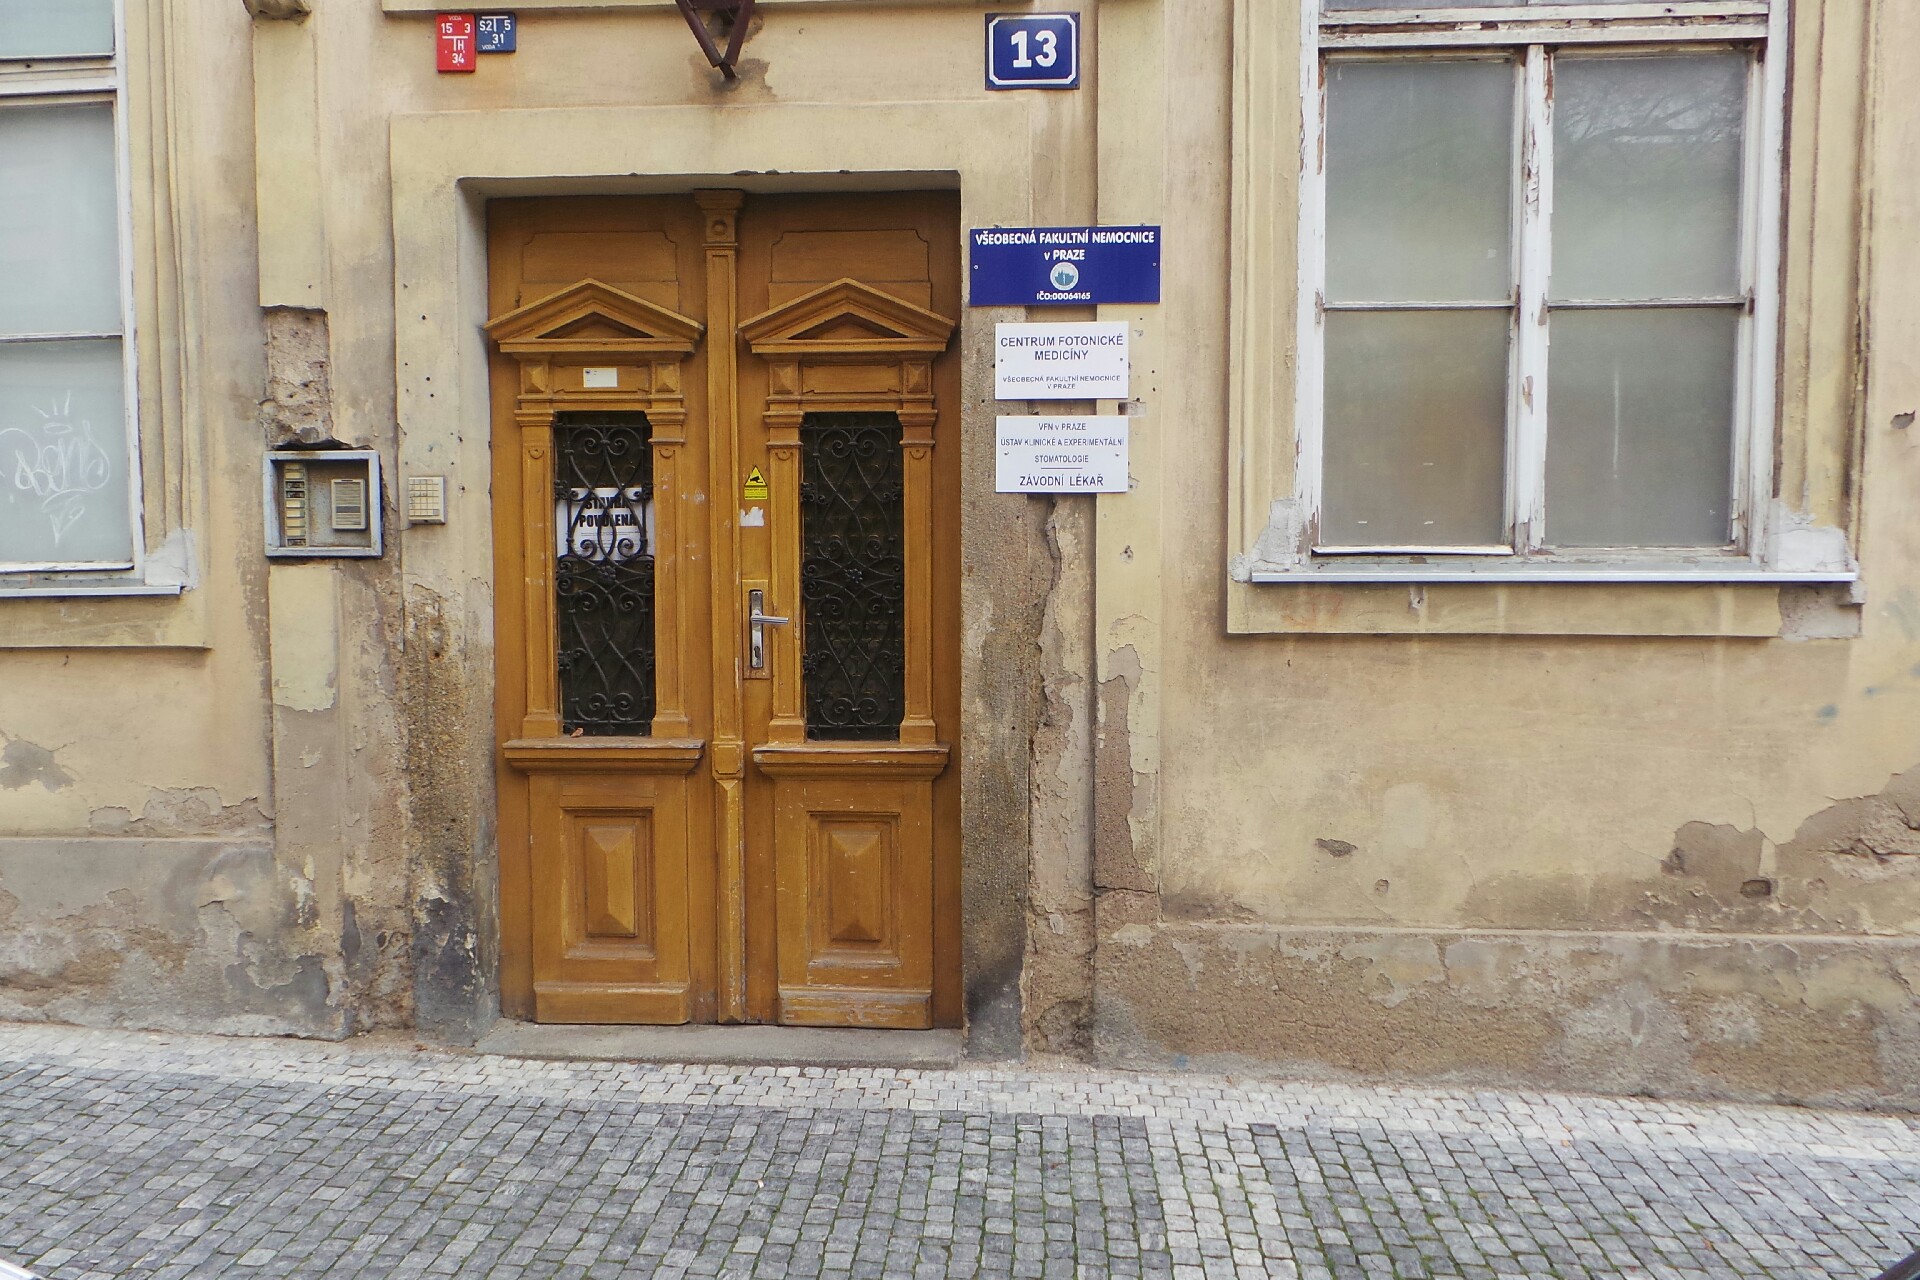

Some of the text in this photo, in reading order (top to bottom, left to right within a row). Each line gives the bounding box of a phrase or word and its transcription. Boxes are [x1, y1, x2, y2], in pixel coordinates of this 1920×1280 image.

[441, 22, 471, 34] 15 3
[480, 20, 511, 31] S2 5
[492, 34, 504, 44] 31
[1010, 29, 1057, 68] 13
[452, 53, 464, 64] 34
[975, 228, 1154, 246] VŠEOBECNÁ FAKULTNÍ NEMOCNICE
[1053, 250, 1086, 260] PRAZE
[1000, 333, 1124, 347] CENTRUM FOTONICKÉ
[1034, 348, 1088, 360] MEDICÍNY
[1038, 422, 1053, 430] VFN
[1061, 422, 1086, 430] PRAZE
[1000, 436, 1022, 446] ÚSTAV
[1024, 436, 1056, 446] KLINICKÉ
[1064, 436, 1124, 446] EXPERIMENTÁLNÍ
[1034, 454, 1088, 462] STOMATOLOGIE
[1020, 474, 1104, 486] ZÁVODNÍ LÉKAŘ
